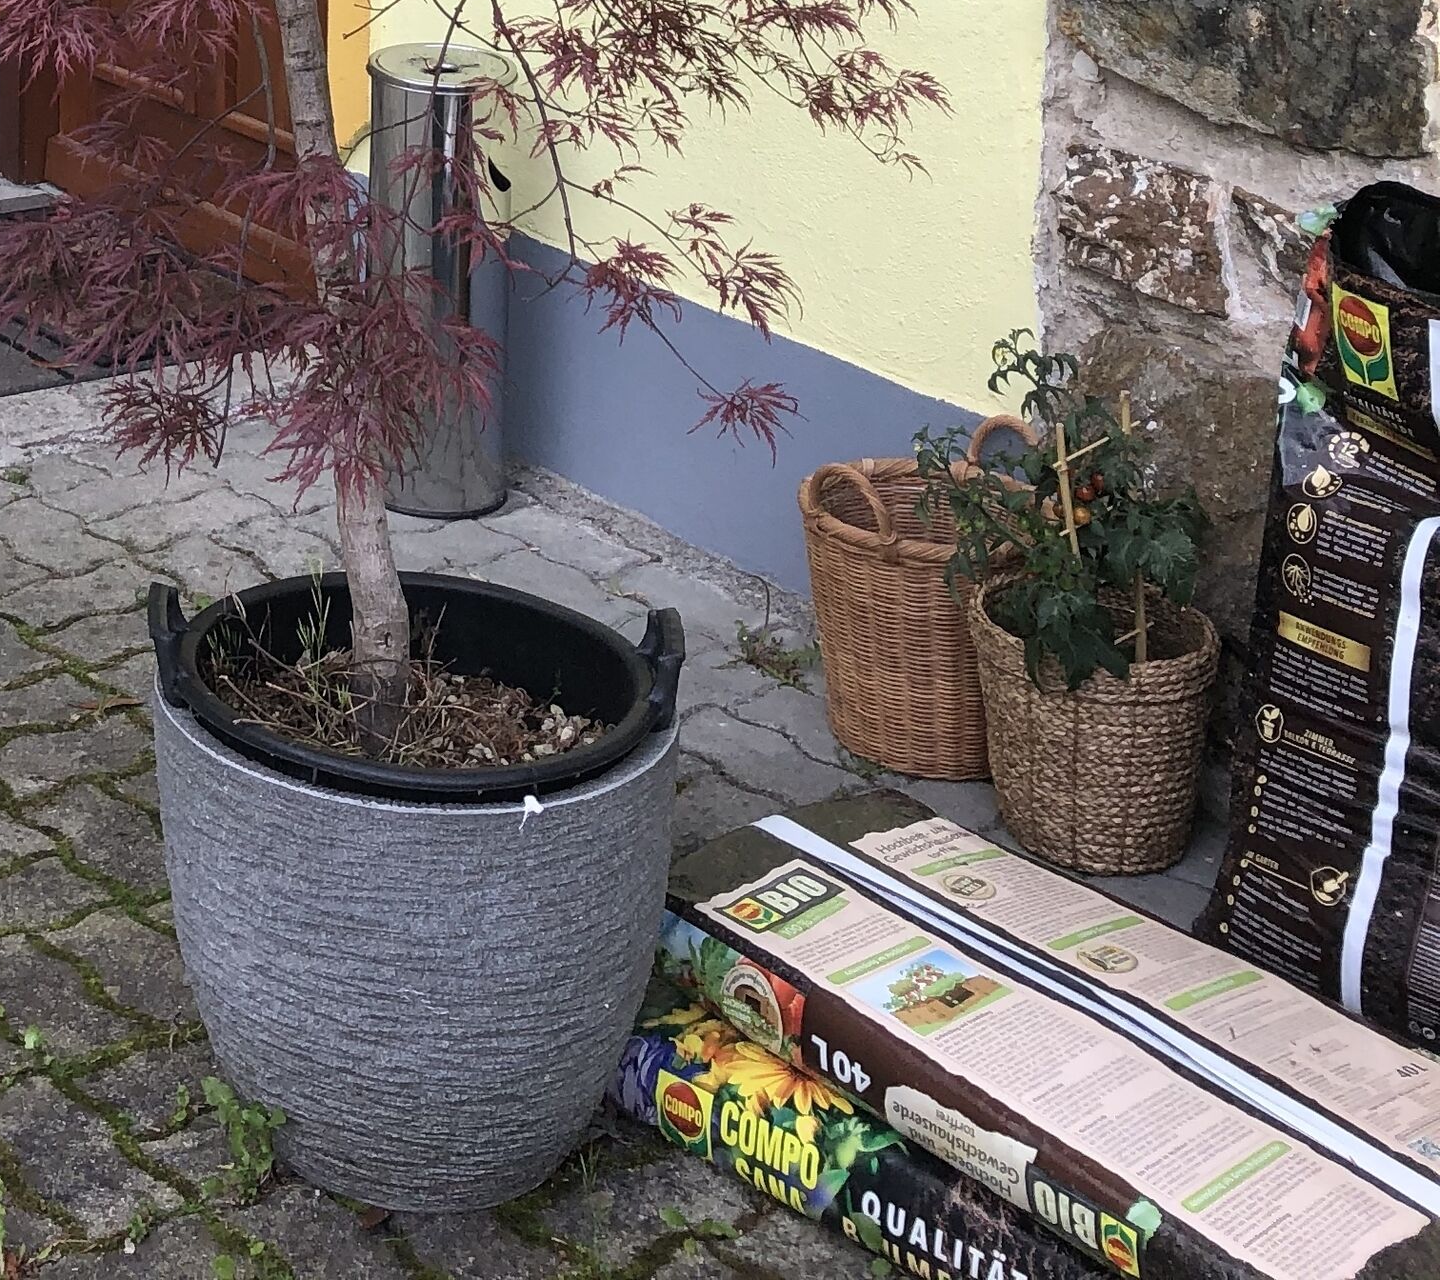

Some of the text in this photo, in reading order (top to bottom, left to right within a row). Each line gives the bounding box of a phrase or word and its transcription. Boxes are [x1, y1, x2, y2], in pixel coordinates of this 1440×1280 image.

[1340, 309, 1380, 343] COMPO
[1340, 441, 1359, 459] 12
[756, 874, 828, 914] BIO
[664, 1093, 703, 1128] COMPO
[720, 1100, 820, 1190] COMPO
[892, 1101, 1020, 1186] Gewächshauserde
[1033, 1180, 1099, 1250] BIO
